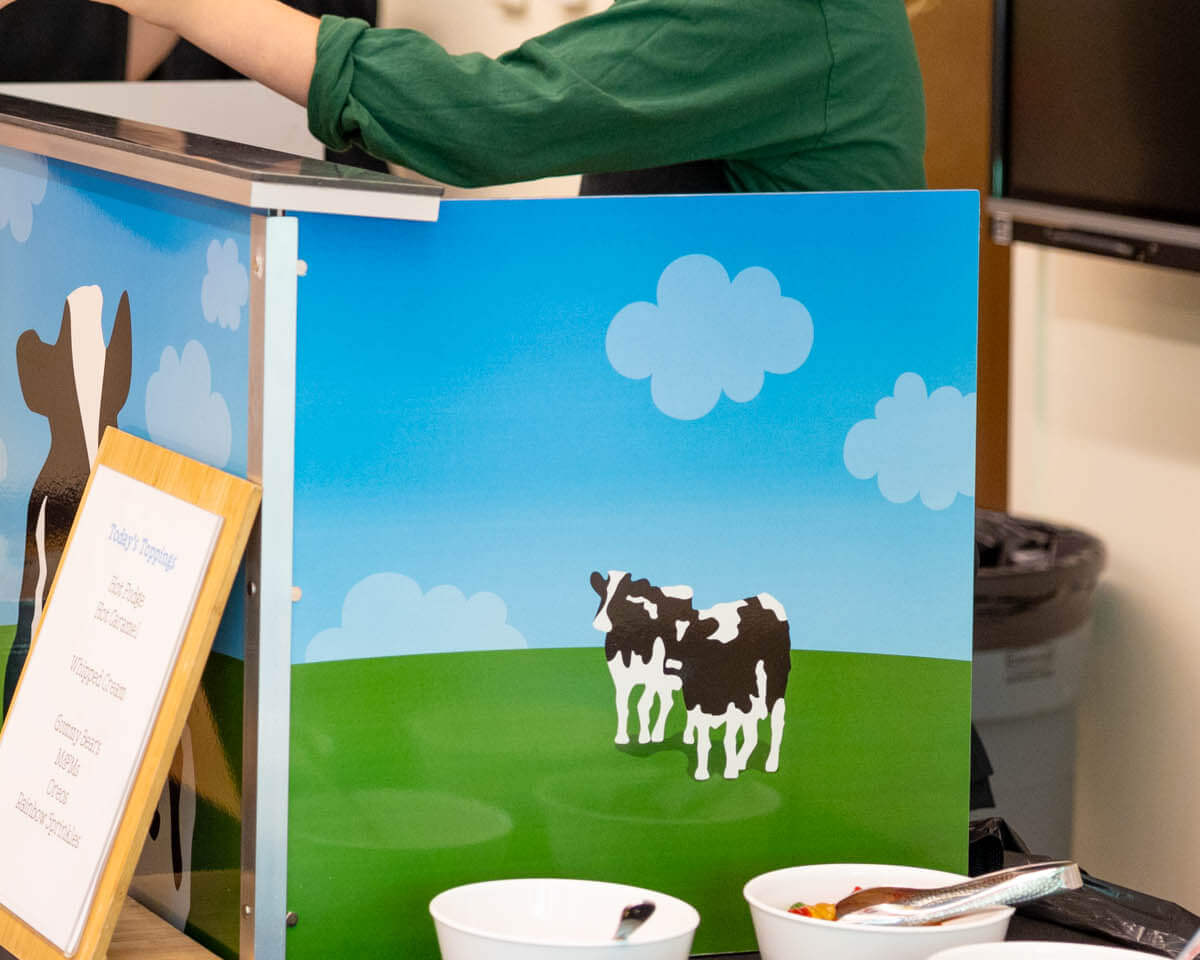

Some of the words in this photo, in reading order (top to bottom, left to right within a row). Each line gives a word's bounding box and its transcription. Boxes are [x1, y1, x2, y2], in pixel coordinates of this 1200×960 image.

[108, 523, 139, 552] Today's
[140, 538, 177, 572] Toppings
[70, 654, 104, 689] Whipped
[102, 672, 127, 700] Cream
[54, 713, 81, 746] Gummy
[80, 729, 103, 755] Bears
[46, 778, 70, 805] Oreos
[15, 792, 48, 825] Rainbow
[45, 812, 83, 849] Sprinkles
